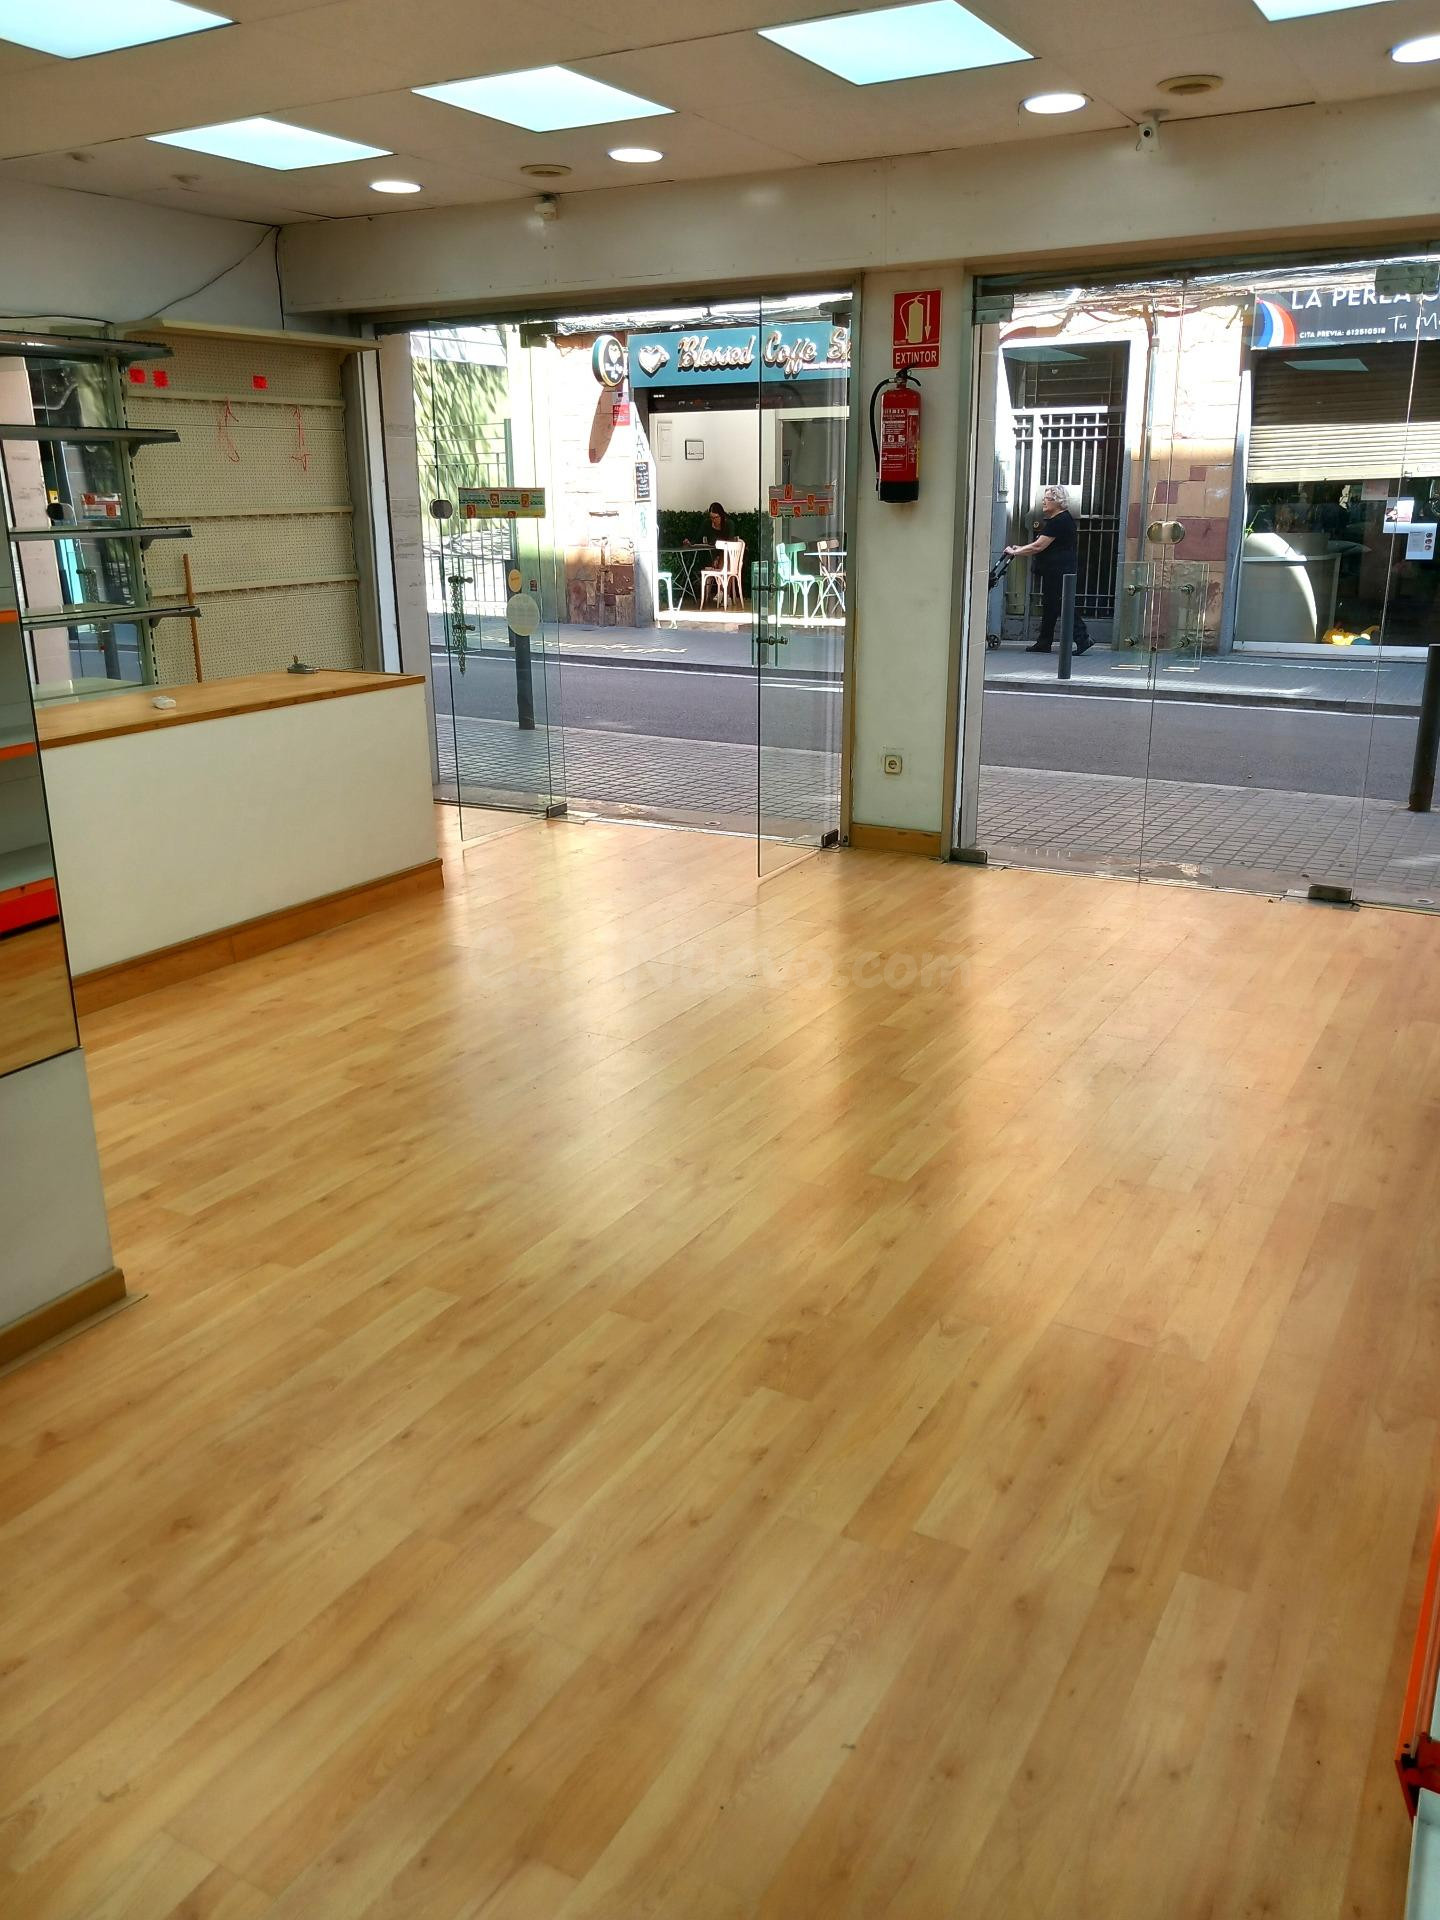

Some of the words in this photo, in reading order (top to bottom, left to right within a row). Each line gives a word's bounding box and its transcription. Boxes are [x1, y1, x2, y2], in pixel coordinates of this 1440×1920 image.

[1291, 288, 1322, 310] LA
[1387, 314, 1408, 333] Tu
[1416, 312, 1440, 330] M
[1317, 330, 1345, 338] PREVIA:
[678, 335, 756, 370] Blessed
[895, 351, 937, 365] EXTINTOR
